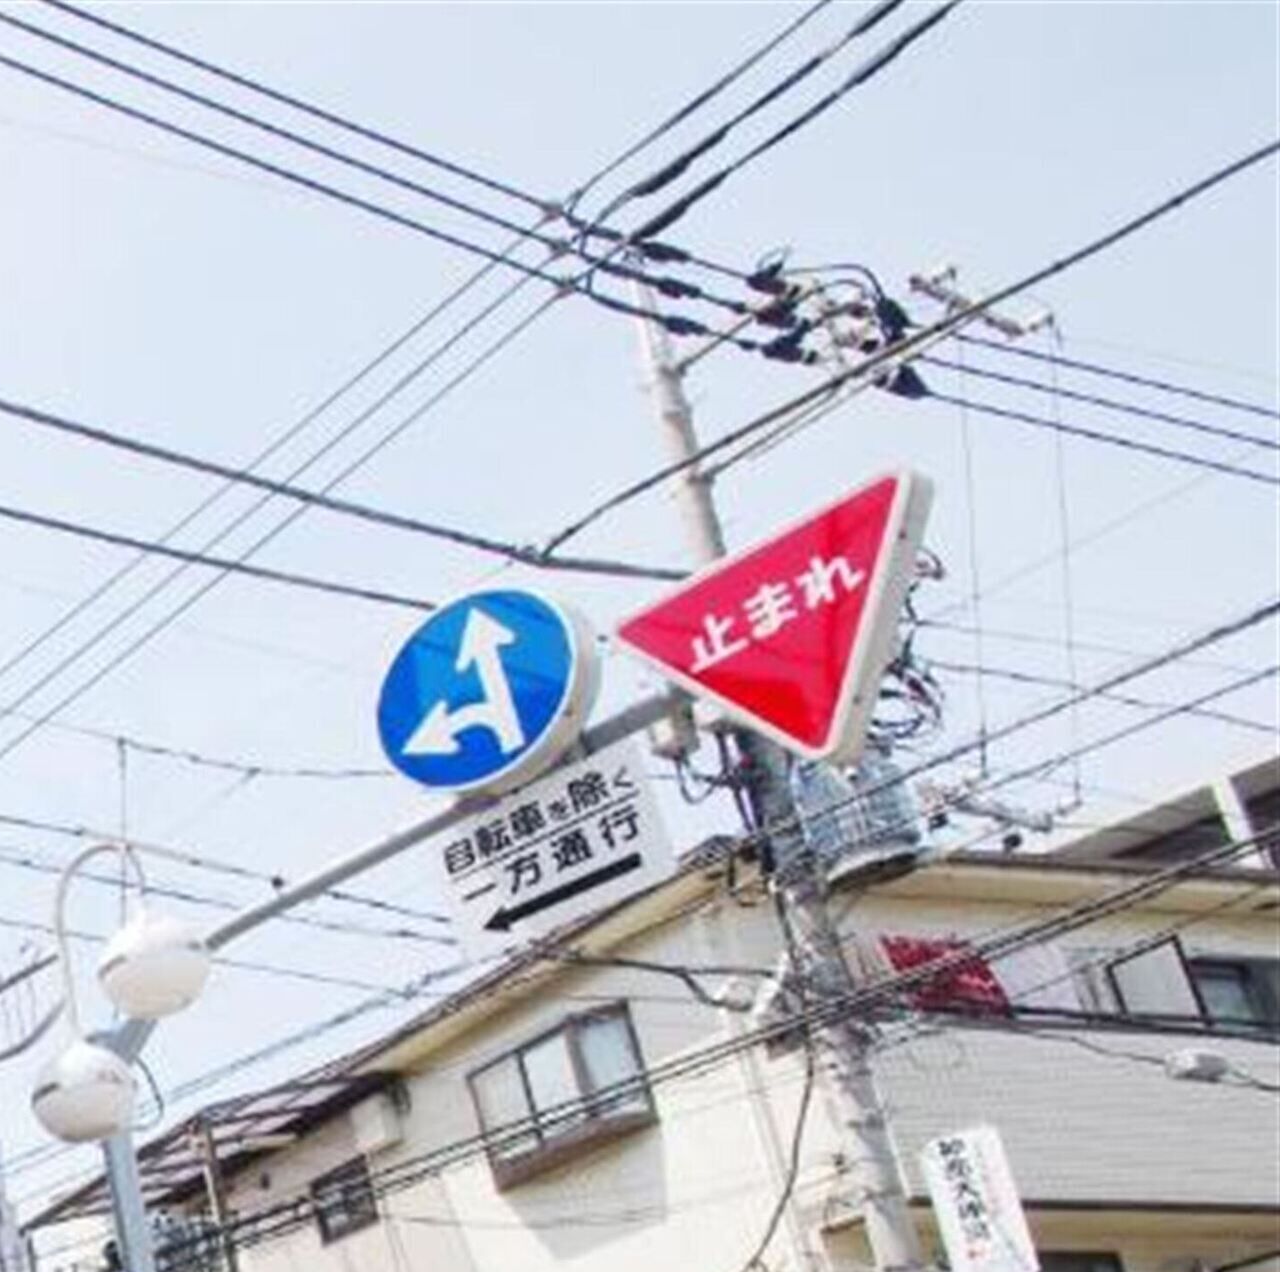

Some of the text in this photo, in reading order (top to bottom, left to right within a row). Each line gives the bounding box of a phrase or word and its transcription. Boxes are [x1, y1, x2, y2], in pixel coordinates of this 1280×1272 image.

[690, 553, 864, 674] 止まれ
[443, 766, 633, 874] 自転車を除く
[462, 804, 639, 902] 一方通行
